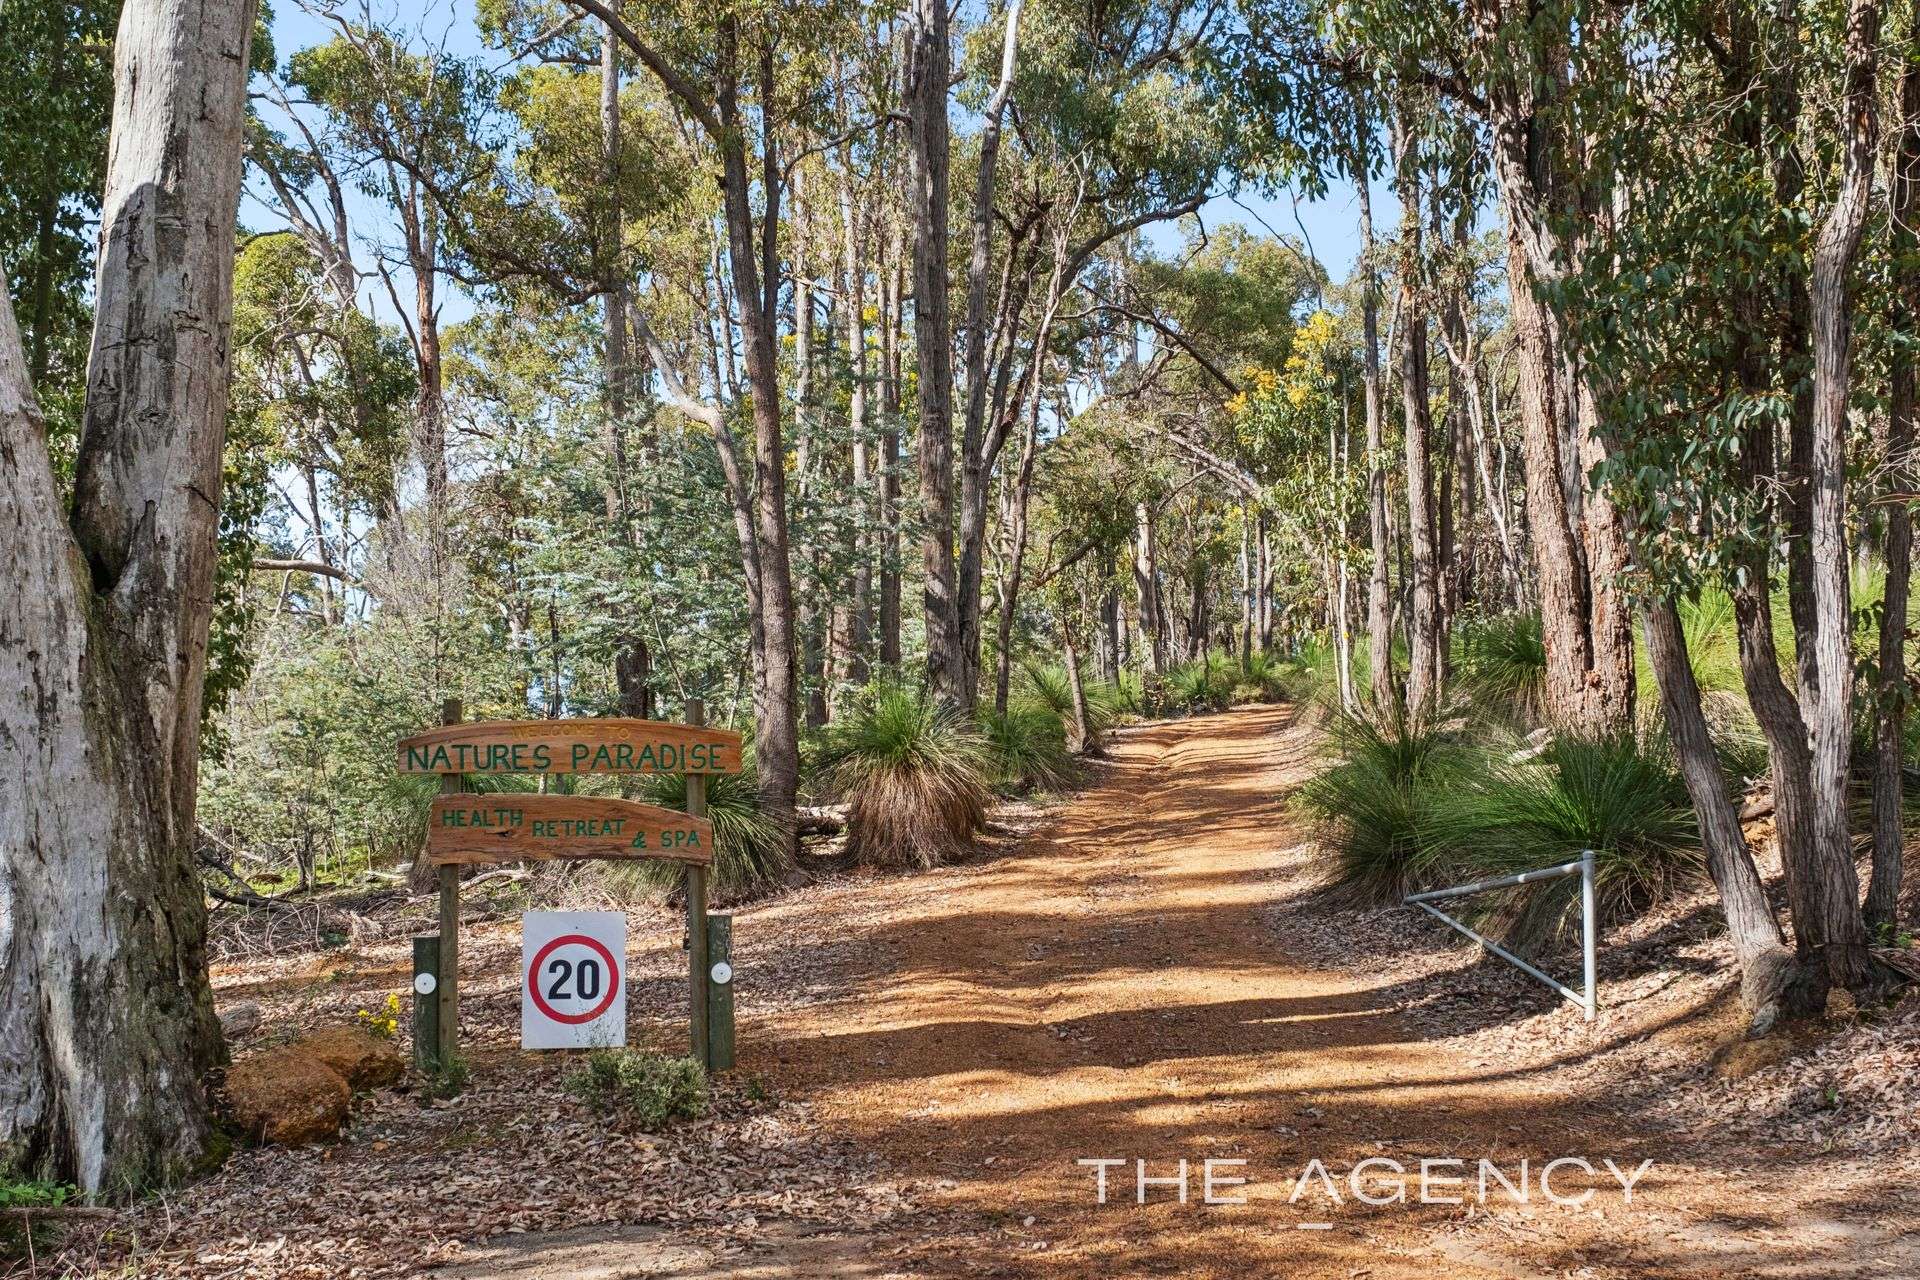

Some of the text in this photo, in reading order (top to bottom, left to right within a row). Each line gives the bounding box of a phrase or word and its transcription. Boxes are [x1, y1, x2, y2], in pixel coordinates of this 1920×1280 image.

[511, 723, 632, 740] WELCOME TO
[406, 744, 727, 771] NATURES PARADISE
[442, 808, 701, 849] HEALTH RETREAT & SPA
[548, 959, 601, 1000] 20
